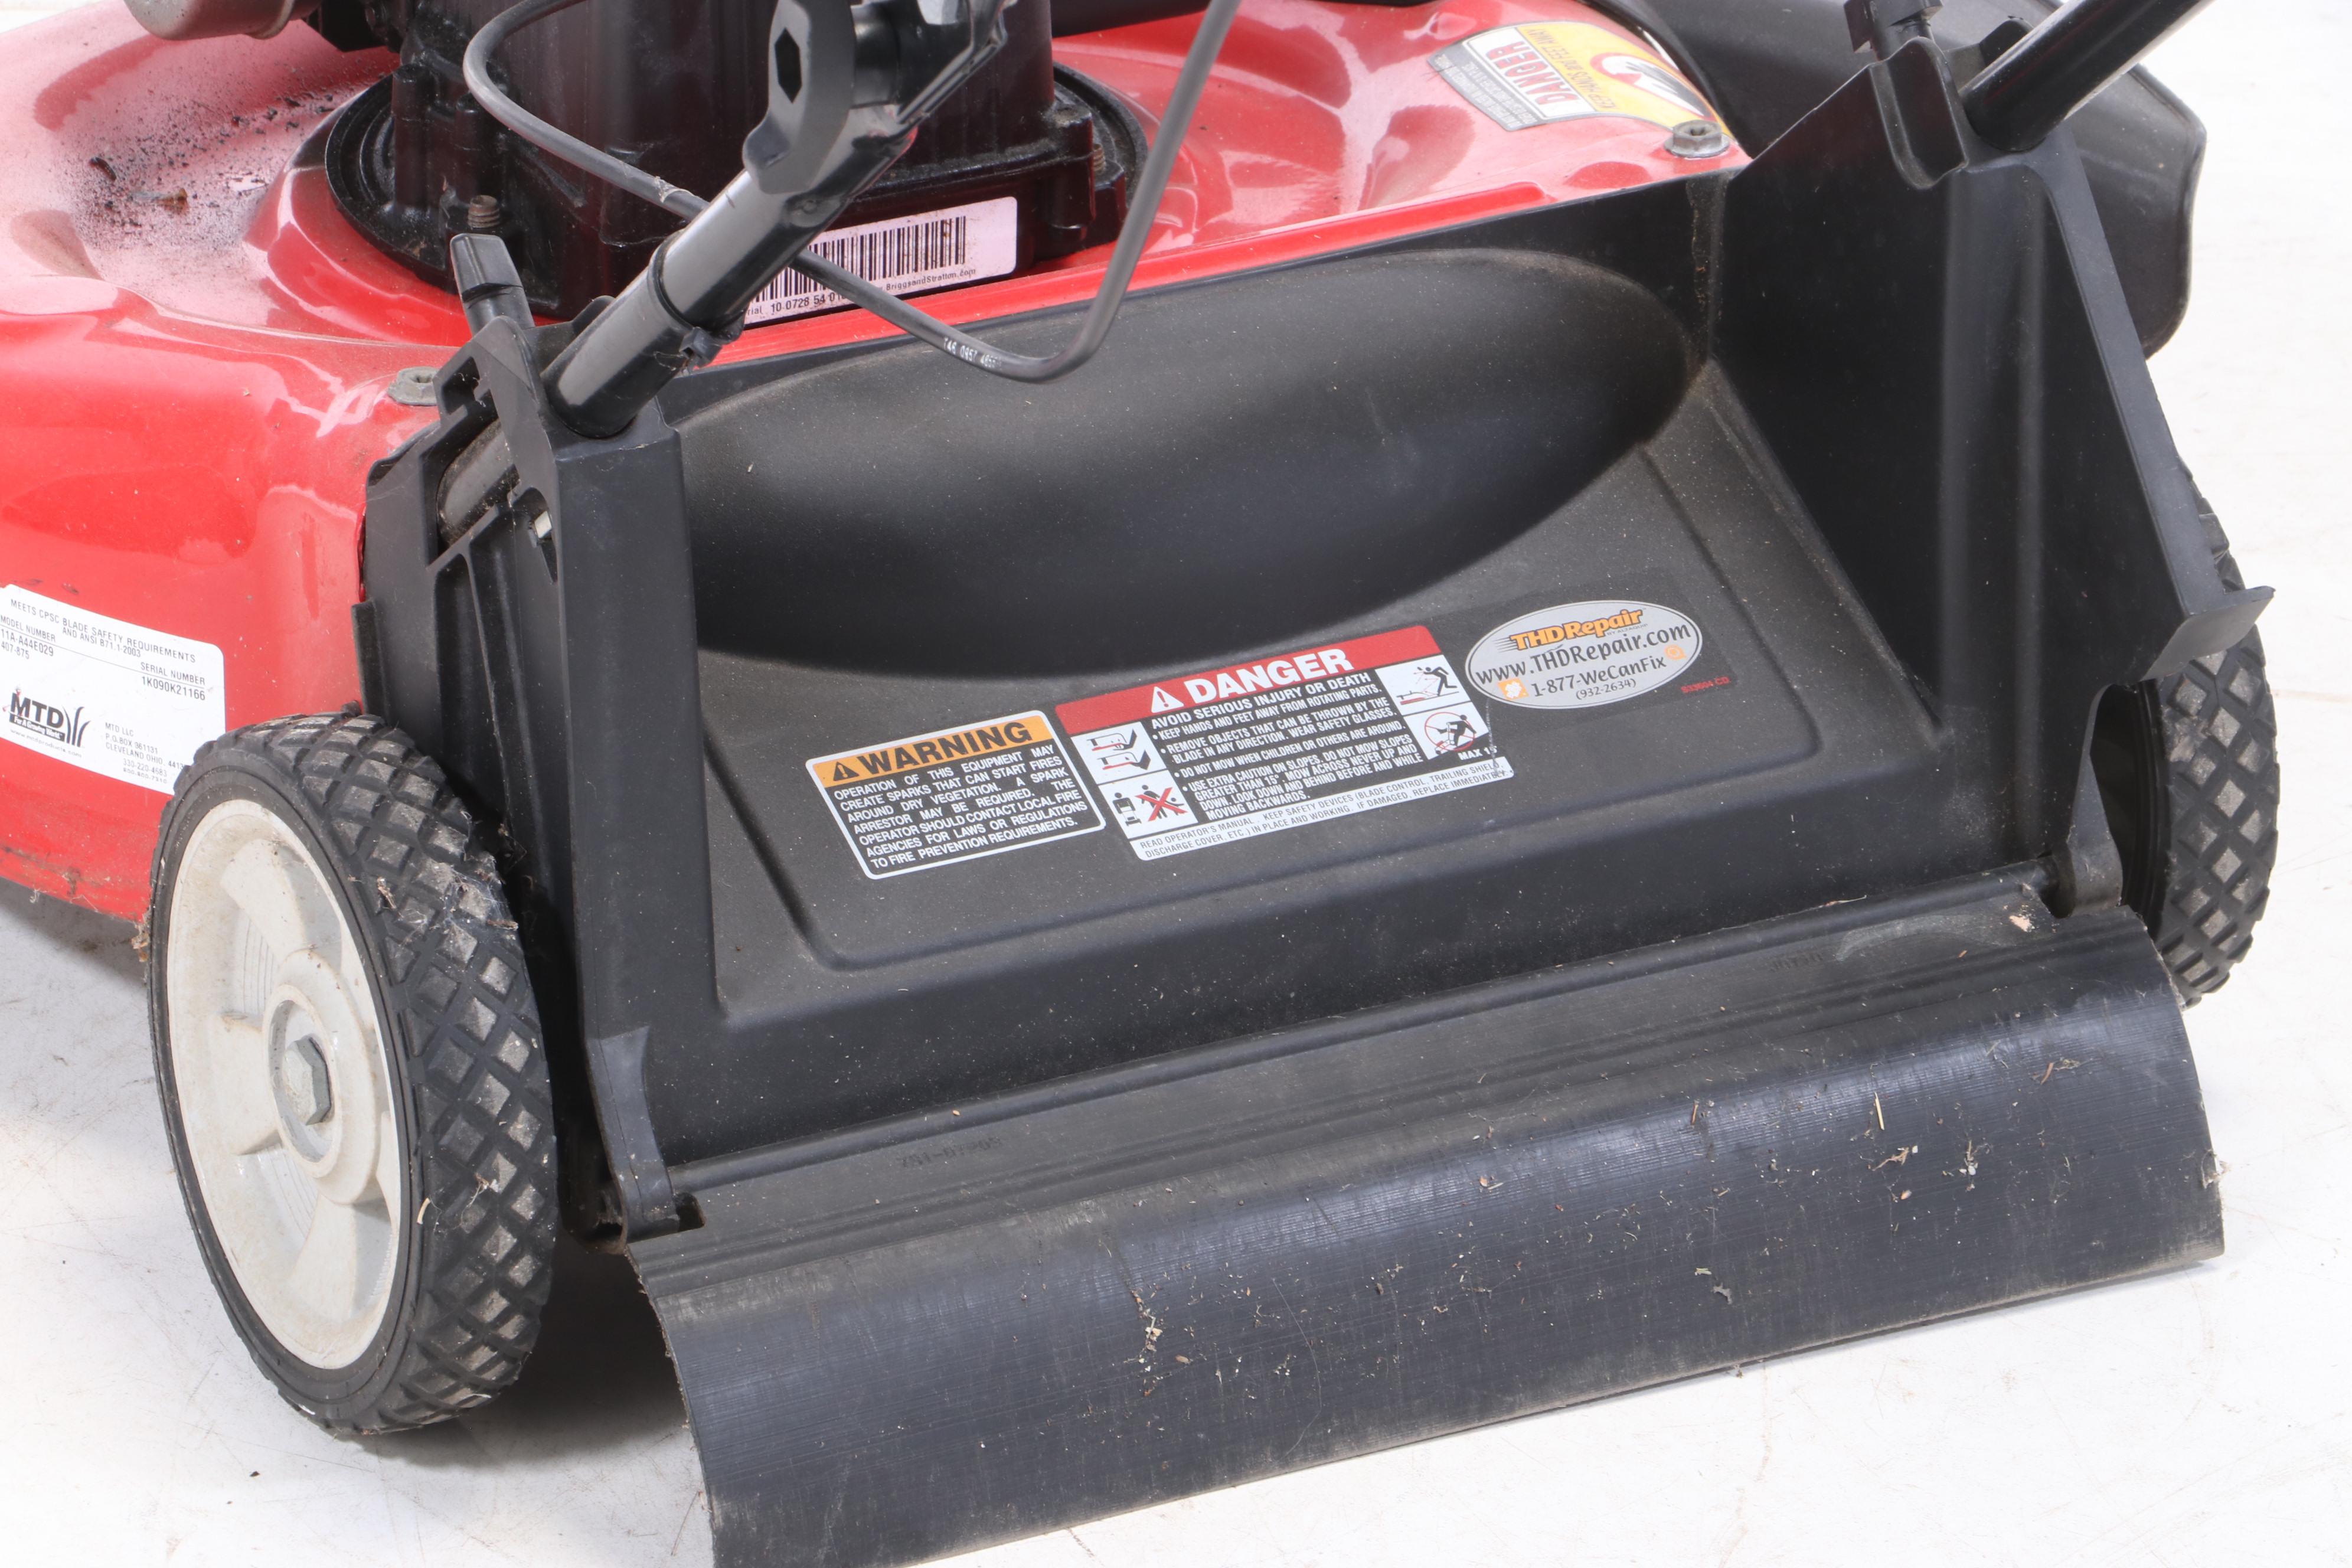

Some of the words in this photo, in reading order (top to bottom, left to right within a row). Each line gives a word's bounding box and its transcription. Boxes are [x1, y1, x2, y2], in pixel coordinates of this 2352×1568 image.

[1485, 41, 1579, 105] DANGER
[772, 302, 782, 312] 10
[785, 297, 810, 310] 0728
[814, 294, 825, 305] 54
[0, 615, 24, 631] MODEL
[26, 625, 56, 642] NUMBER
[1, 629, 54, 656] 11A-A44E029
[1, 641, 30, 659] 407-875
[11, 599, 37, 615] MEETS
[39, 609, 60, 623] CPSC
[63, 618, 88, 633] BLADE
[92, 627, 123, 643] SAFETY
[127, 638, 196, 663] REQUIREMENTS
[63, 627, 77, 638] AND
[80, 633, 97, 645] ANSI
[1476, 624, 1691, 685] www.THDRepair.com
[1510, 609, 1643, 651] THDRepair
[141, 662, 168, 676] SERIAL
[171, 670, 205, 685] NUMBER
[142, 676, 205, 701] 1K090K21166
[1184, 649, 1354, 704] DANGER
[1530, 655, 1667, 698] 1-877-WeCanFix
[1575, 678, 1636, 700] (932-2634)
[11, 692, 64, 729] MTD
[1151, 711, 1192, 730] AVOID
[1193, 698, 1253, 719] SERIOUS
[1253, 687, 1302, 706] INJURY
[1305, 682, 1327, 694] OR
[1327, 672, 1371, 690] DEATH
[1158, 727, 1181, 740] KEEP
[1181, 720, 1213, 735] HANDS
[1213, 716, 1233, 728] AND
[1232, 711, 1255, 724] FEET
[1255, 705, 1280, 719] AWAY
[1279, 699, 1308, 713] FROM
[1306, 690, 1350, 707] ROTATING
[1348, 684, 1382, 698] PARTS.
[1166, 737, 1208, 754] REMOVE
[1207, 727, 1250, 744] OBJECTS
[1249, 722, 1275, 735] THAT
[1276, 717, 1298, 730] CAN
[1296, 714, 1312, 725] BE
[1311, 704, 1355, 721] THROWN
[1354, 701, 1368, 712] BY
[1368, 697, 1390, 709] THE
[10, 729, 82, 758] www.mtdproducts.com
[105, 722, 119, 733] MTD
[122, 727, 133, 737] LLC
[106, 742, 145, 759] CLEVELAND
[135, 741, 158, 754] 361131
[857, 722, 1033, 775] WARNING
[1172, 749, 1204, 764] BLADE
[1203, 746, 1216, 757] IN
[1216, 741, 1235, 754] ANY
[1235, 731, 1289, 750] DIRECTION.
[1288, 724, 1318, 738] WEAR
[1316, 716, 1351, 731] SAFETY
[1351, 707, 1397, 724] GLASSES.
[1180, 767, 1195, 778] DO
[1193, 762, 1213, 775] NOT
[1211, 757, 1236, 771] MOW
[1234, 752, 1262, 766] WHEN
[1260, 743, 1304, 760] CHILDREN
[1302, 740, 1317, 750] OR
[1315, 732, 1350, 747] OTHERS
[1349, 728, 1368, 740] ARE
[1367, 720, 1406, 736] AROUND.
[1458, 749, 1484, 760] MAX
[123, 759, 168, 777] 330-220-4683
[834, 779, 897, 800] OPERATION
[904, 773, 919, 785] OF
[927, 767, 954, 780] THIS
[961, 751, 1023, 773] EQUIPMENT
[1030, 744, 1054, 758] MAY
[840, 793, 885, 811] CREATE
[886, 785, 932, 802] SPARKS
[932, 777, 962, 792] THAT
[965, 771, 991, 785] CAN
[991, 763, 1027, 779] START
[1029, 756, 1063, 771] FIRES
[1188, 779, 1208, 792] USE
[1206, 773, 1237, 788] EXTRA
[1234, 765, 1274, 782] CAUTION
[1272, 762, 1288, 773] ON
[1286, 754, 1324, 770] SLOPES.
[1322, 750, 1338, 762] DO
[1336, 746, 1355, 759] NOT
[1354, 741, 1379, 754] MOW
[1378, 734, 1413, 749] SLOPES
[1194, 783, 1239, 802] GREATER
[1236, 778, 1265, 793] THAN
[1284, 767, 1311, 781] MOW
[1311, 758, 1350, 775] ACROSS
[1349, 752, 1383, 766] NEVER
[1381, 748, 1395, 759] UP
[1397, 743, 1417, 756] AND
[1199, 796, 1232, 811] DOWN.
[1230, 790, 1257, 805] LOOK
[1255, 784, 1285, 798] DOWN
[1284, 780, 1304, 792] AND
[1302, 772, 1337, 788] BEHIND
[1335, 764, 1373, 780] BEFORE
[1373, 759, 1393, 772] AND
[1391, 753, 1423, 767] WHILE
[847, 805, 894, 823] AROUND
[900, 798, 923, 811] DRY
[929, 782, 1002, 805] VEGETATION.
[1016, 777, 1026, 787] A
[1030, 766, 1069, 783] SPARK
[854, 814, 913, 834] ARRESTOR
[919, 806, 943, 820] MAY
[950, 801, 969, 814] BE
[975, 788, 1035, 808] REQUIRED.
[1050, 778, 1076, 791] THE
[859, 825, 920, 845] OPERATOR
[919, 815, 965, 833] SHOULD
[965, 803, 1017, 823] CONTACT
[1017, 796, 1056, 812] LOCAL
[1054, 789, 1082, 803] FIRE
[1139, 838, 1164, 849] READ
[1164, 825, 1217, 844] OPERATOR'S
[1262, 810, 1283, 821] KEEP
[1285, 803, 1316, 816] SAFETY
[1318, 794, 1354, 808] DEVICES
[1355, 787, 1386, 801] (BLADE
[1386, 778, 1429, 793] CONTROL,
[1429, 768, 1469, 783] TRAILING
[1145, 841, 1194, 858] DISCHARGE
[1194, 834, 1227, 846] COVER,
[1262, 819, 1290, 831] PLACE
[1291, 815, 1308, 825] AND
[1308, 805, 1353, 820] WORKING.
[1357, 801, 1364, 809] IF
[1366, 792, 1412, 807] DAMAGED,
[1412, 782, 1451, 796] REPLACE
[1205, 803, 1247, 821] MOVING
[1245, 790, 1311, 811] BACKWARDS.
[866, 837, 923, 857] AGENCIES
[925, 831, 951, 844] FOR
[953, 823, 986, 838] LAWS
[989, 818, 1008, 830] OR
[1010, 801, 1088, 826] REGULATIONS
[870, 857, 888, 868] TO
[888, 851, 916, 865] FIRE
[917, 835, 989, 859] PREVENTION
[988, 816, 1078, 844] REQUIREMENTS.
